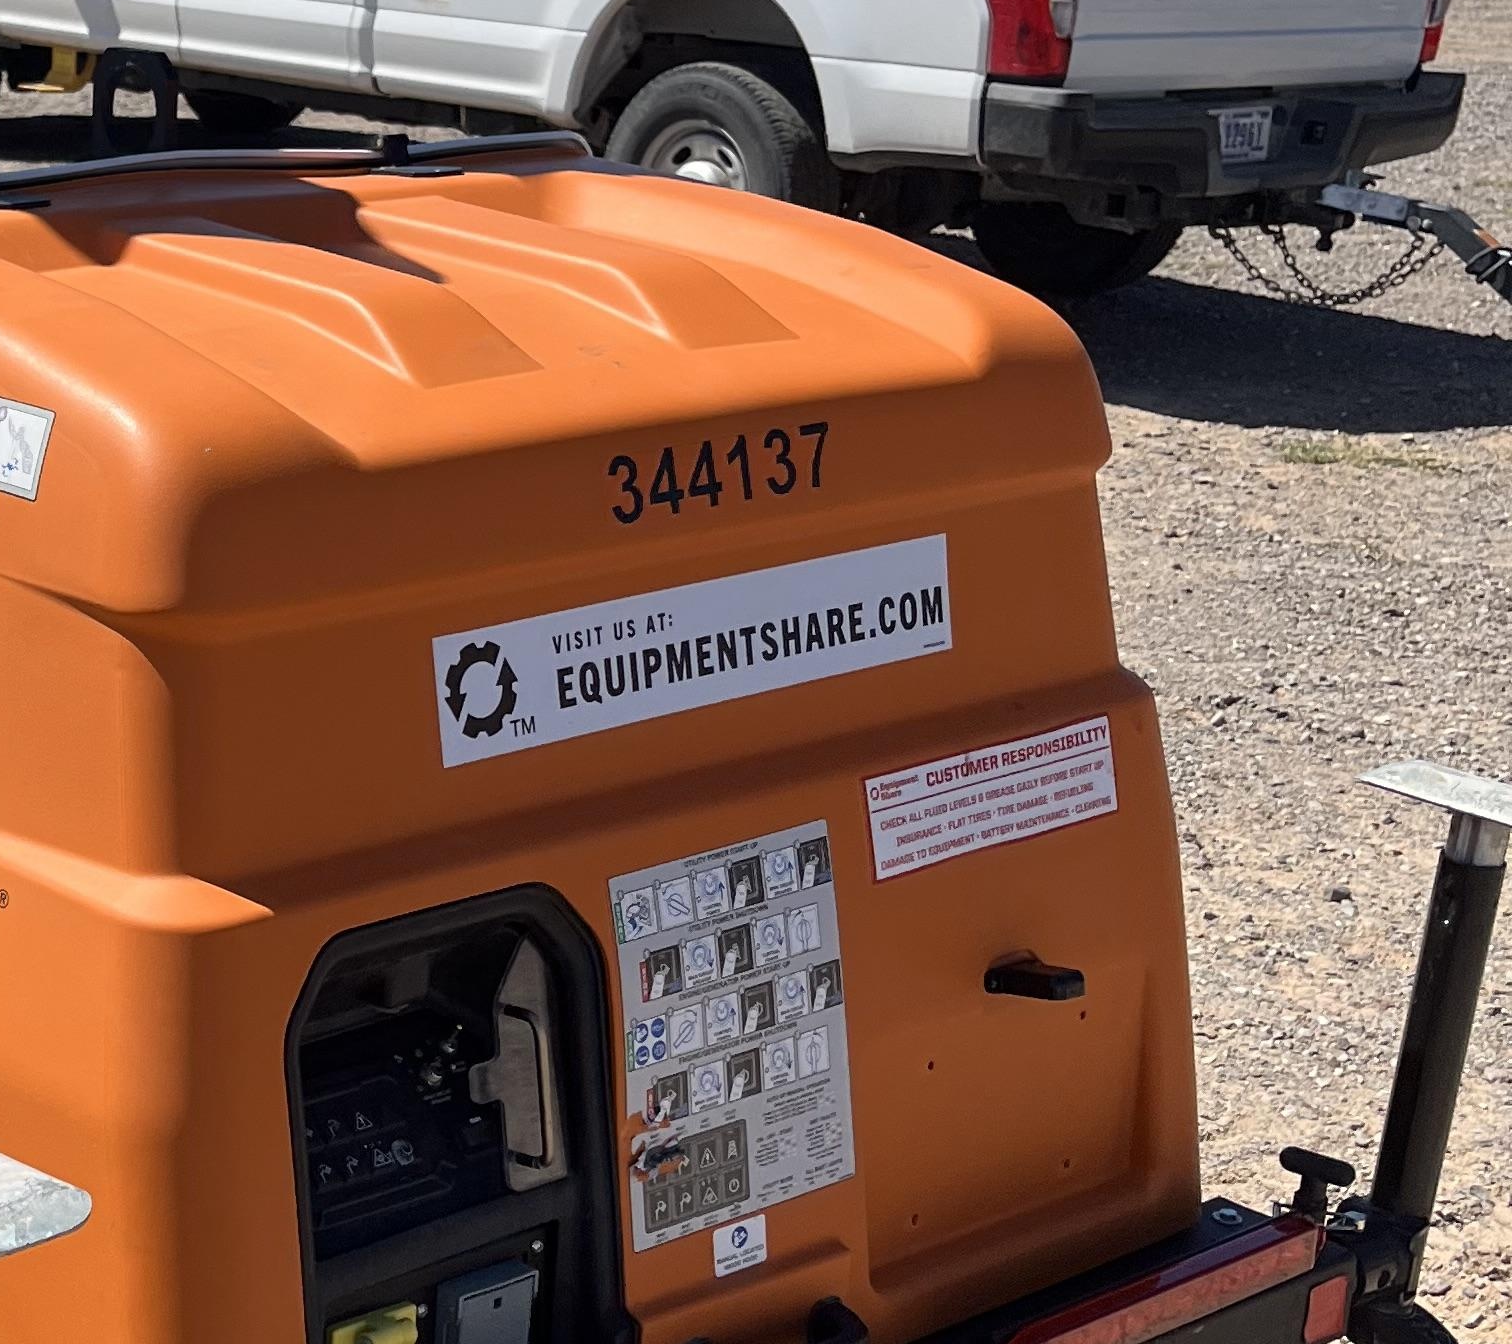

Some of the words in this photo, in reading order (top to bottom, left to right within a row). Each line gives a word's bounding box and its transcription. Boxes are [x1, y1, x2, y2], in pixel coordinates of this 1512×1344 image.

[607, 421, 830, 525] 344137
[552, 628, 603, 655] VISIT
[613, 619, 637, 640] US
[646, 613, 674, 634] AT:
[556, 586, 944, 709] EQUIPMENTSHARE.COM
[510, 716, 536, 738] TM
[925, 754, 999, 787] CUSTOMER
[1001, 725, 1107, 766] RESPONSIBILITY
[880, 817, 908, 831] CHECK
[909, 812, 923, 826] ALL
[924, 804, 948, 820] FLUID
[949, 795, 977, 812] LEVELS
[896, 825, 942, 847] INSURANCE
[947, 818, 967, 831] FLAT
[967, 811, 992, 826] TIRES
[1017, 795, 1048, 812] DAMAGE
[881, 853, 915, 871] DAMAGE
[916, 848, 926, 860] TO
[928, 833, 975, 857] EQUIPMENT
[981, 824, 1014, 840] BATTERY
